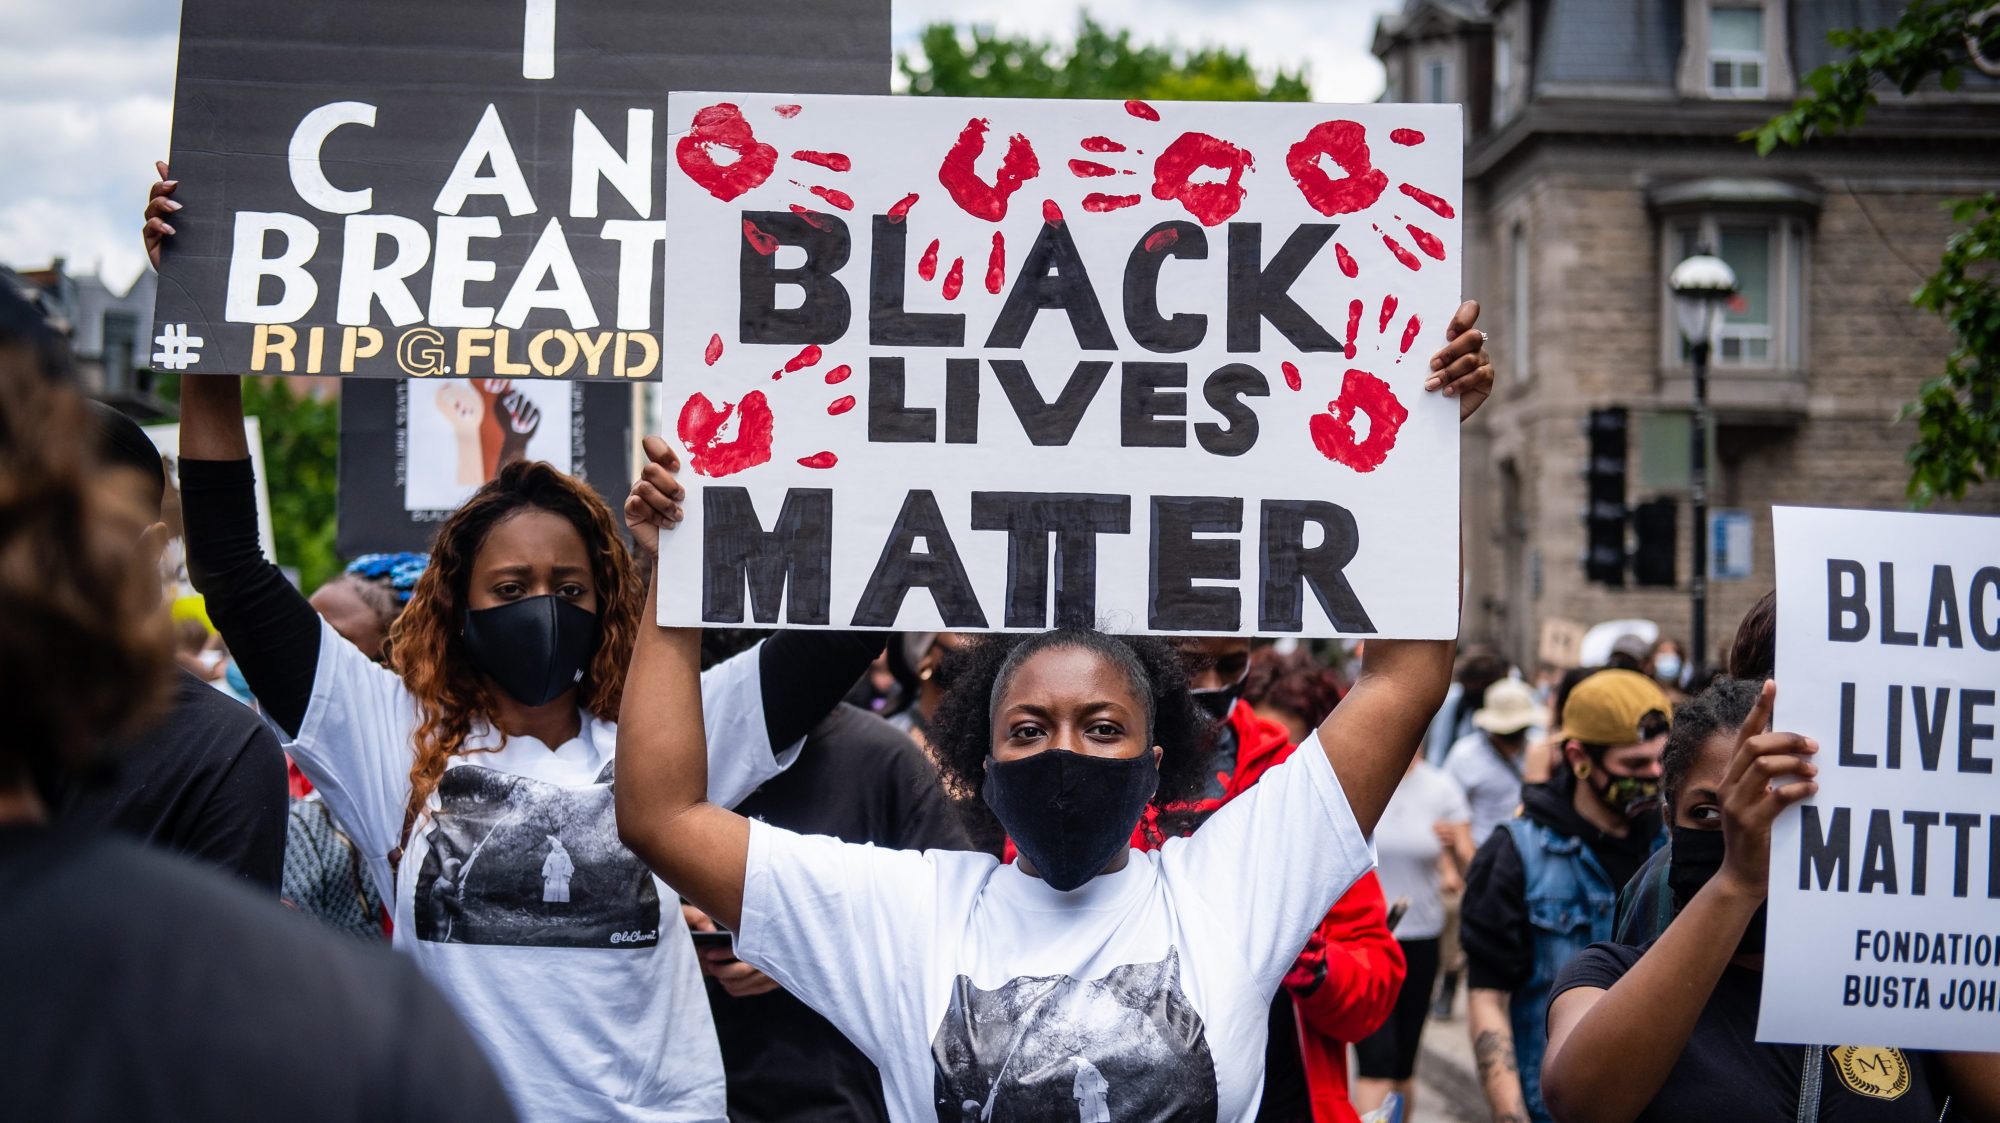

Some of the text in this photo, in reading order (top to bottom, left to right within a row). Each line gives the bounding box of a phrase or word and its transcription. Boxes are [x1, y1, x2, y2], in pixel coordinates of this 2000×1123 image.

[522, 0, 556, 80] I
[288, 101, 654, 219] CAN
[225, 210, 666, 331] BREAT
[740, 209, 1345, 354] BLACK
[868, 357, 1271, 457] LIVES
[702, 486, 1376, 632] MATTER
[1827, 558, 2000, 652] BLAC
[1838, 682, 1995, 774] LIVE
[1843, 974, 2000, 1012] BUSTA JOH
